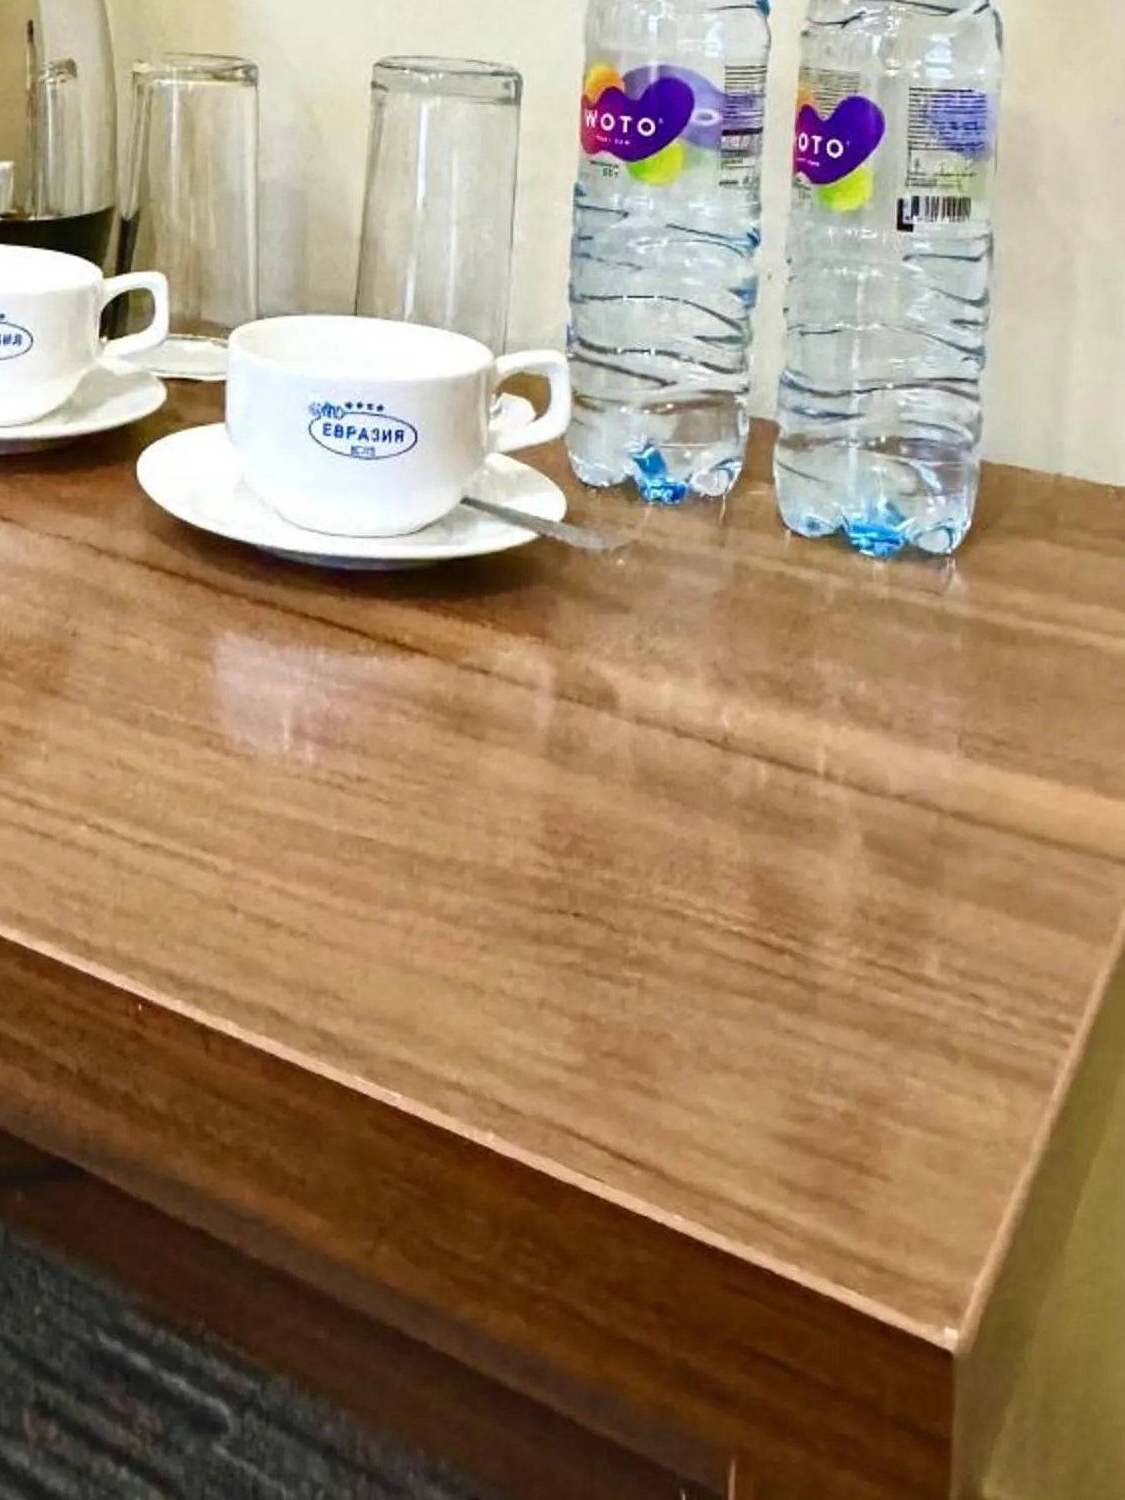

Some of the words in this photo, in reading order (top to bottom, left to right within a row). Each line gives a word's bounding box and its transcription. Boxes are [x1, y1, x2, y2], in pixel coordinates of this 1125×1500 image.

[584, 109, 656, 137] WOTO
[797, 132, 844, 158] OTO
[322, 422, 405, 443] ЕВРАЗИЯ
